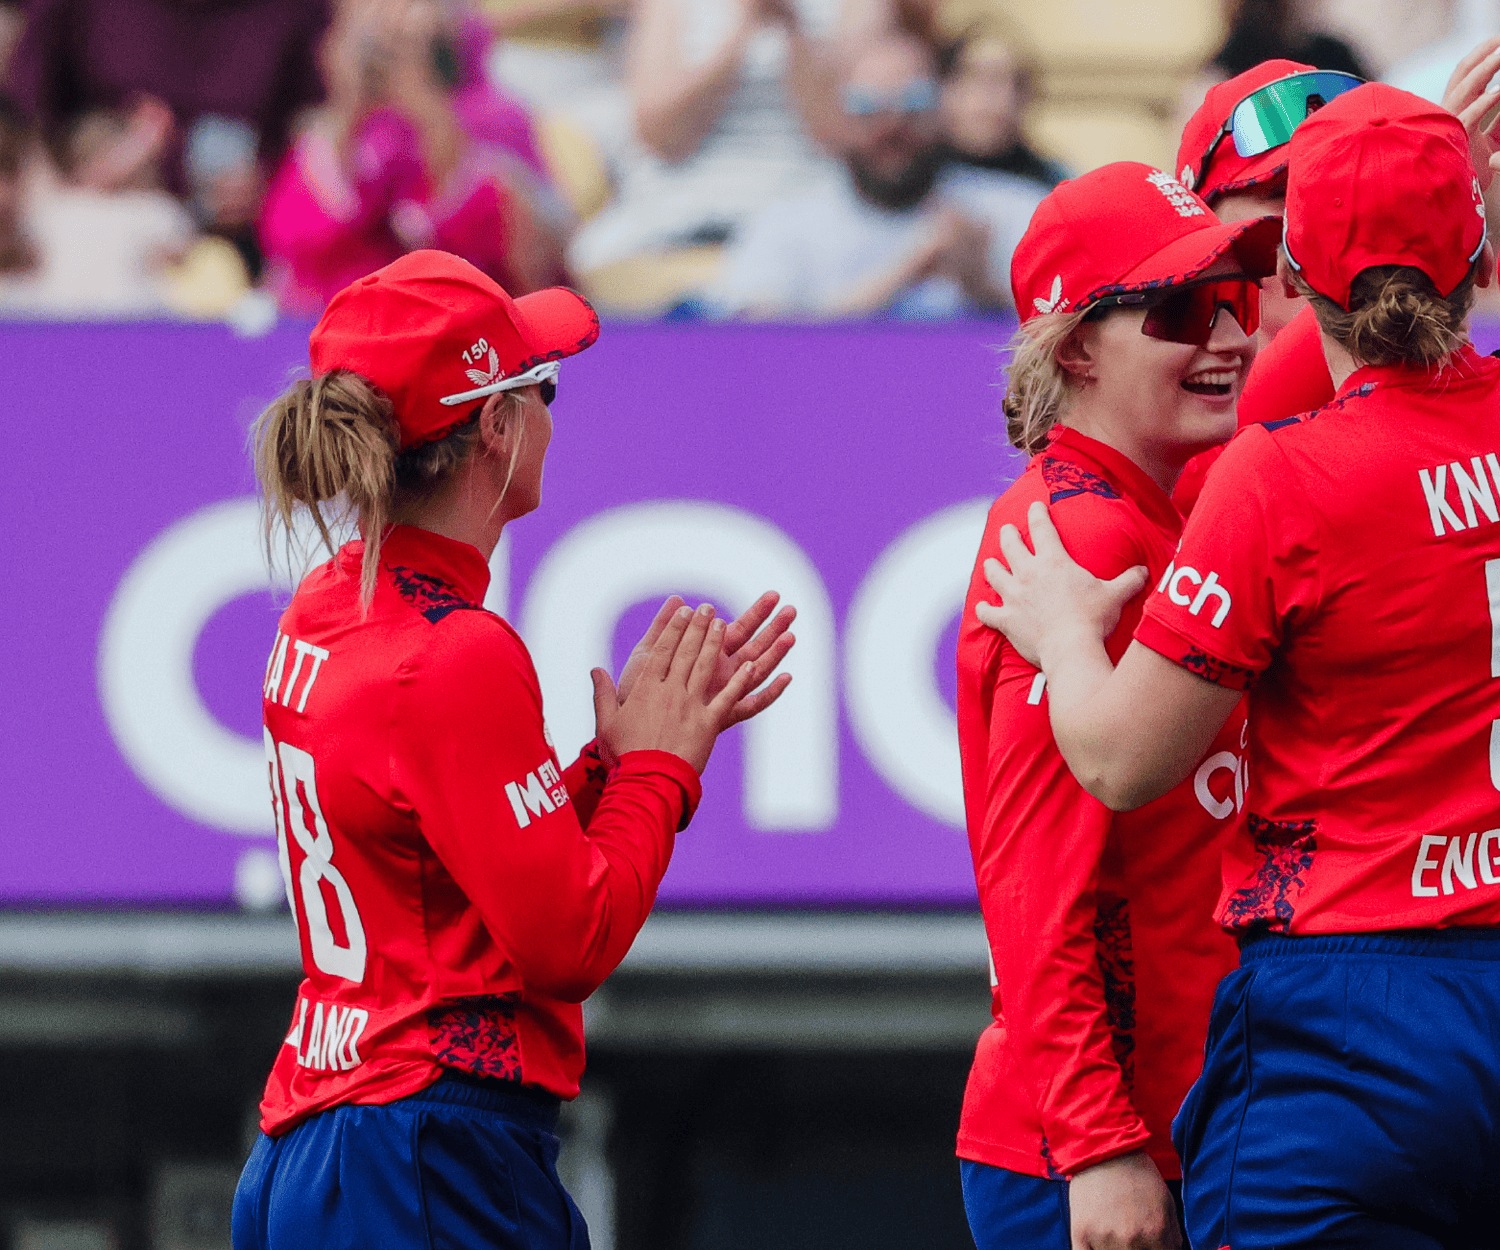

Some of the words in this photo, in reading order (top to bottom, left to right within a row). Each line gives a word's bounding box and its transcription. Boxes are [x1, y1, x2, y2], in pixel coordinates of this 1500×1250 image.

[461, 337, 489, 365] 150
[262, 630, 331, 714] ATT
[285, 997, 369, 1072] LAND
